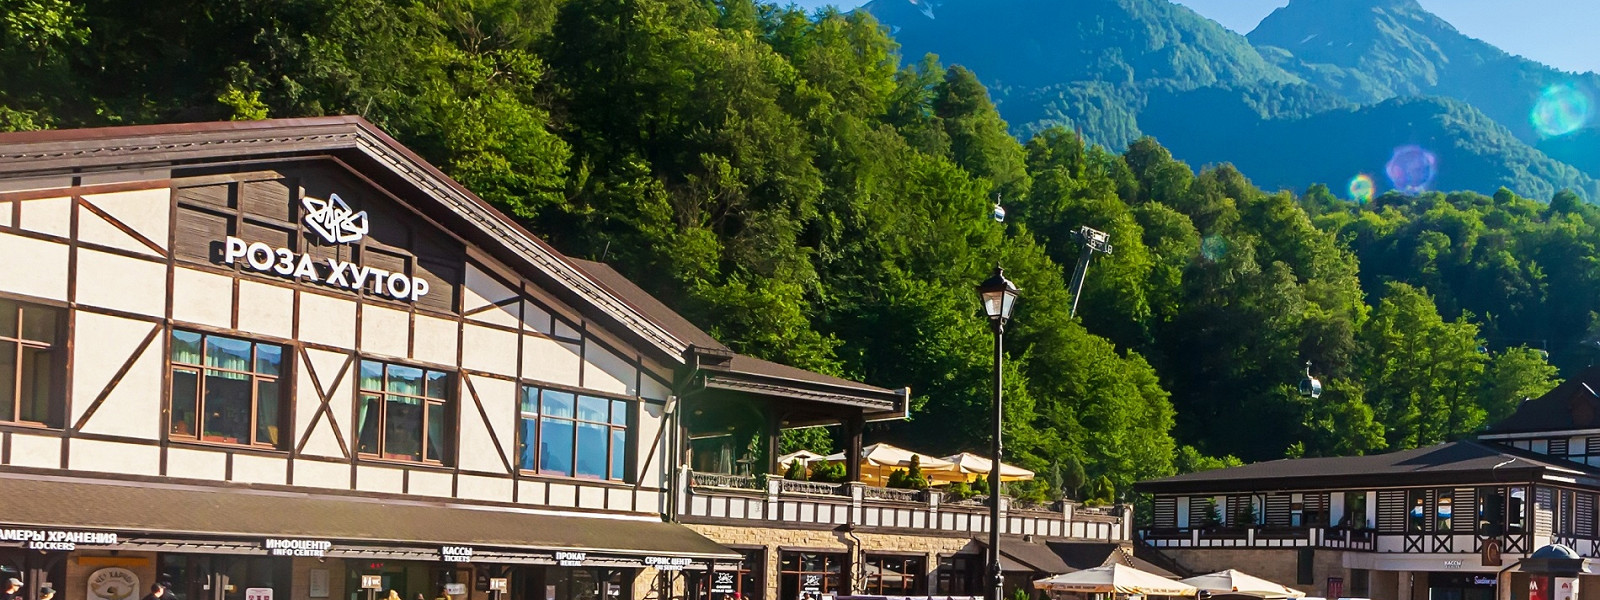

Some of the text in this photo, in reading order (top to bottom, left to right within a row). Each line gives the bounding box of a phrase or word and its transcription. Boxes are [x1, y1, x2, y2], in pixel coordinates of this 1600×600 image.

[225, 236, 429, 301] РОЗА ХУТОР
[47, 531, 117, 544] ХРАНЕНИЯ
[30, 541, 75, 551] LOCKERS
[266, 539, 331, 550] ИНФОЦЕНТР
[442, 546, 472, 556] КАССЫ
[556, 551, 586, 560] ПРОКАТ
[645, 556, 692, 566] СЕРВИС ЦЕНТР
